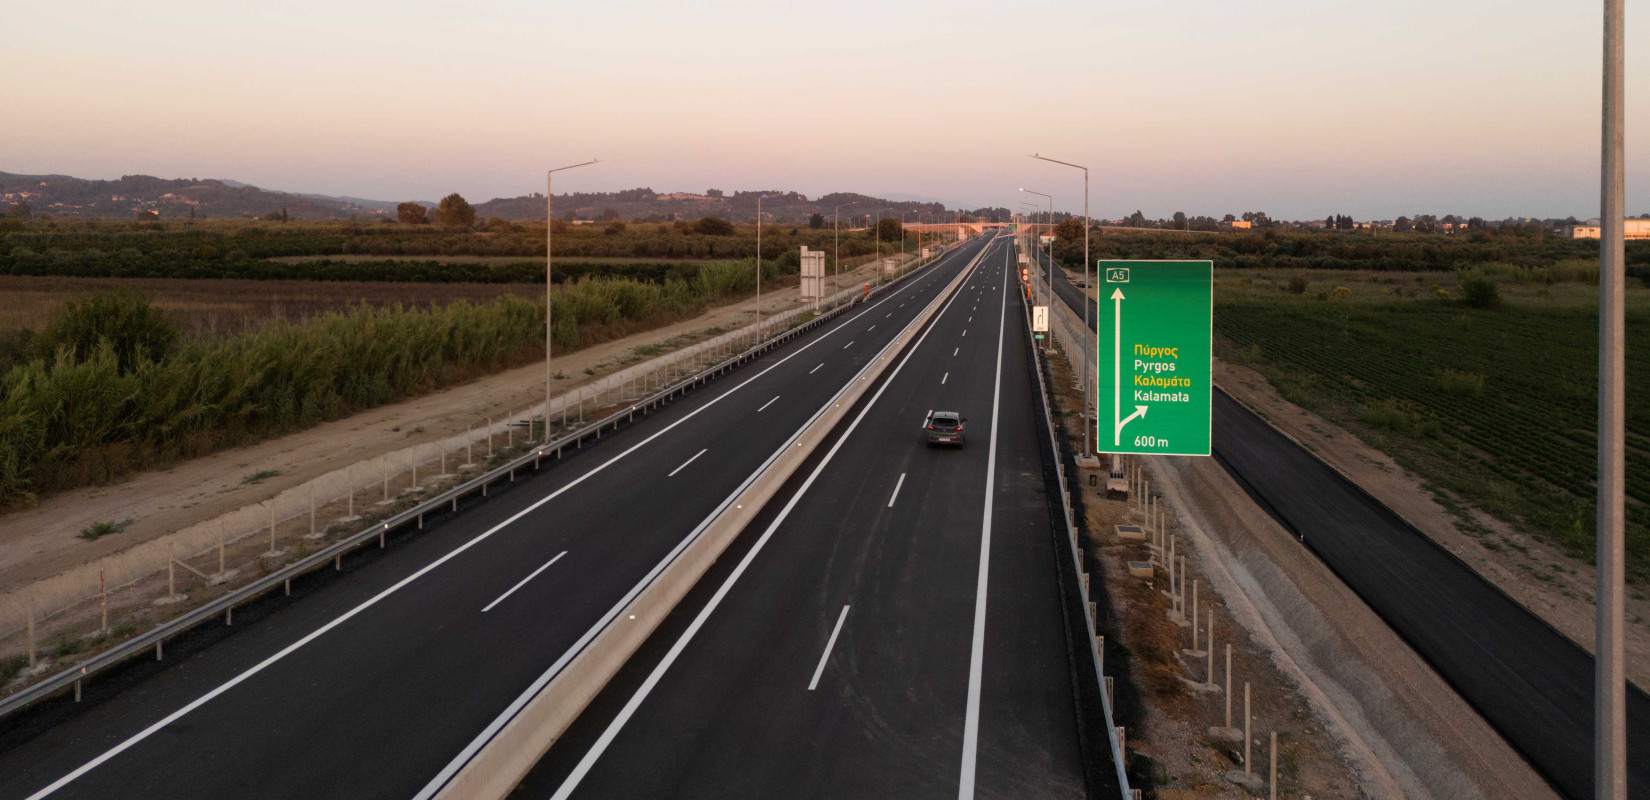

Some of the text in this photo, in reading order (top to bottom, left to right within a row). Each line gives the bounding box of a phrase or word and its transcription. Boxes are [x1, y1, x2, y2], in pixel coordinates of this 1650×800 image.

[1112, 271, 1124, 280] A5
[1134, 344, 1178, 359] Πύργος
[1134, 360, 1176, 374] Pyrgos
[1134, 375, 1191, 389] Καλαμάτα
[1134, 390, 1189, 402] Kalamata
[1134, 436, 1169, 447] 600 m
